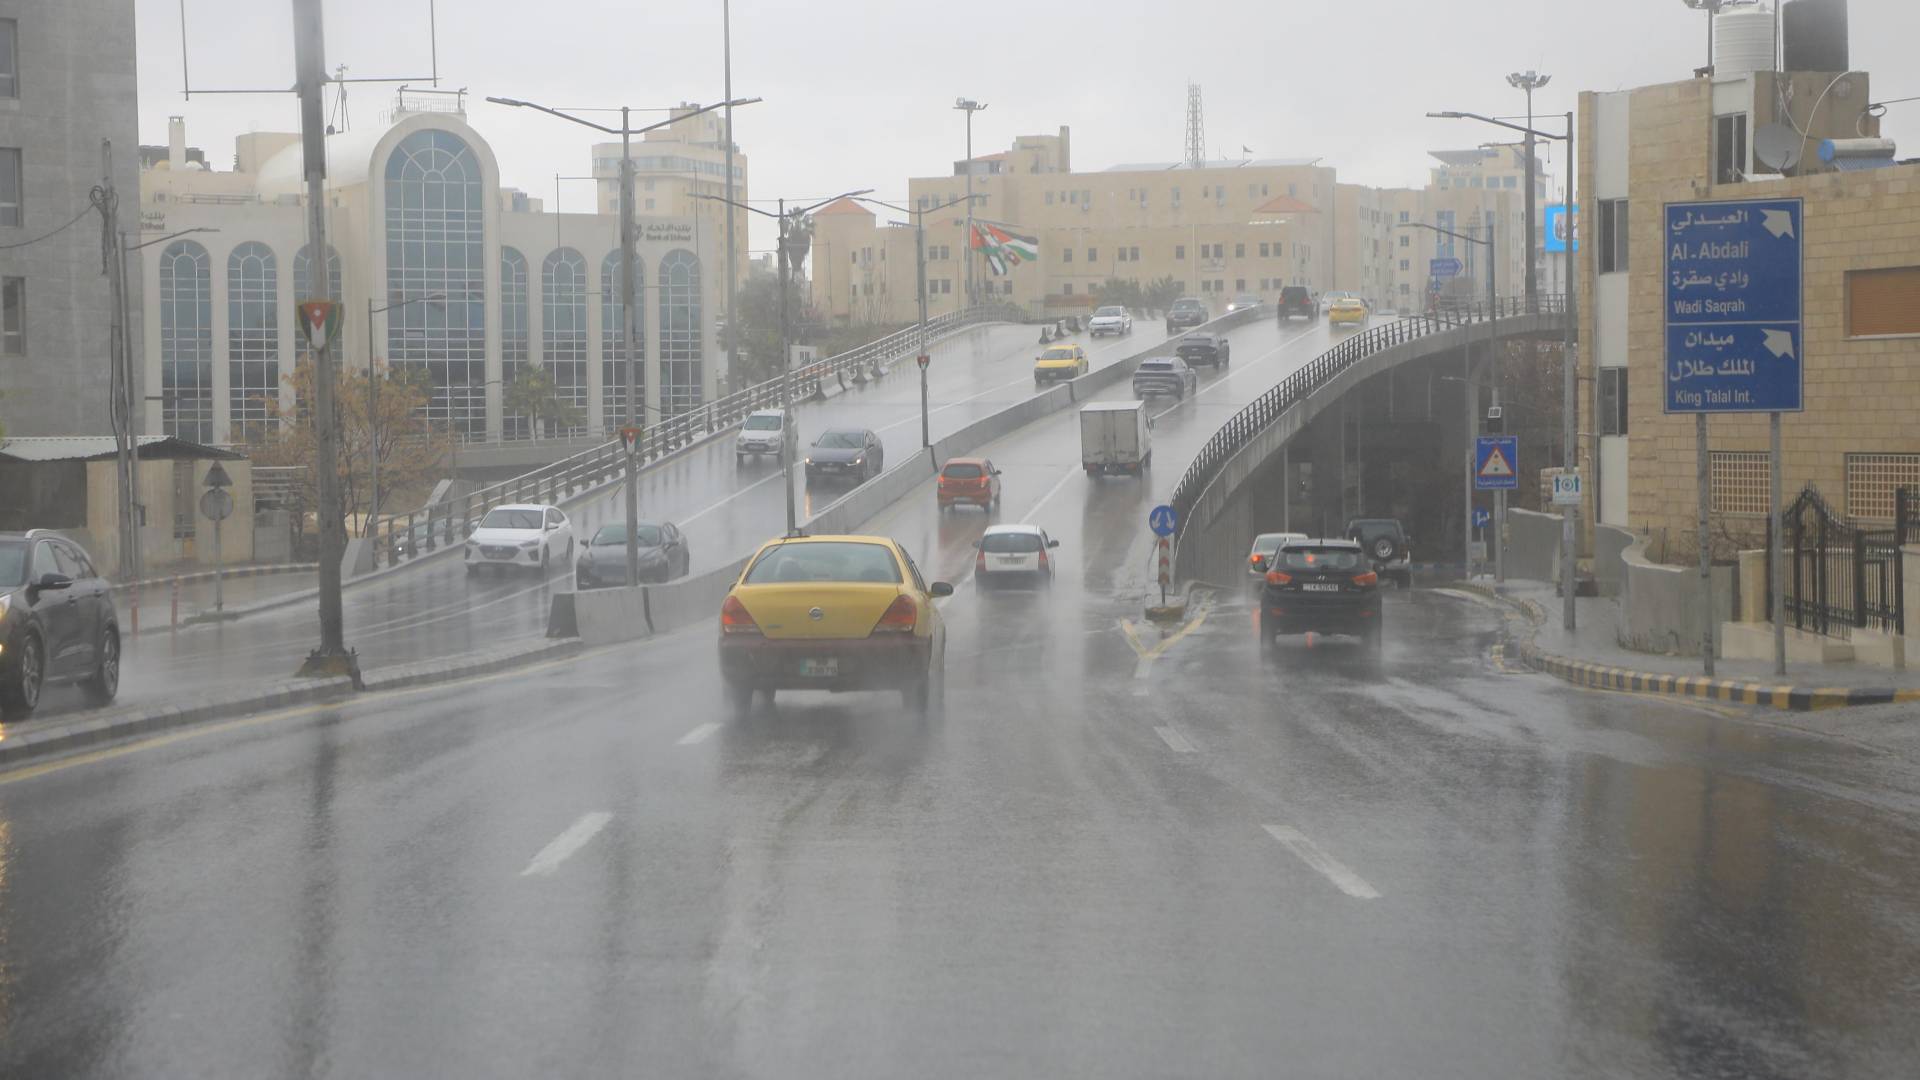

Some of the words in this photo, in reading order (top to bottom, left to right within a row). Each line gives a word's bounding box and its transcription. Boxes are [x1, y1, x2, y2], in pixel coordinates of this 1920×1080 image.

[1671, 209, 1749, 236] العبدلي
[1671, 242, 1688, 261] Al
[1698, 240, 1749, 260] Abdali
[1672, 269, 1713, 290] صقرة
[1714, 270, 1749, 291] وادي
[1673, 299, 1702, 315] Wadi
[1704, 298, 1746, 316] Saqrah
[1684, 331, 1735, 351] ميدان
[1669, 359, 1715, 382] طلال
[1716, 359, 1755, 377] الملك
[1675, 389, 1702, 407] King
[1704, 389, 1732, 404] Talal
